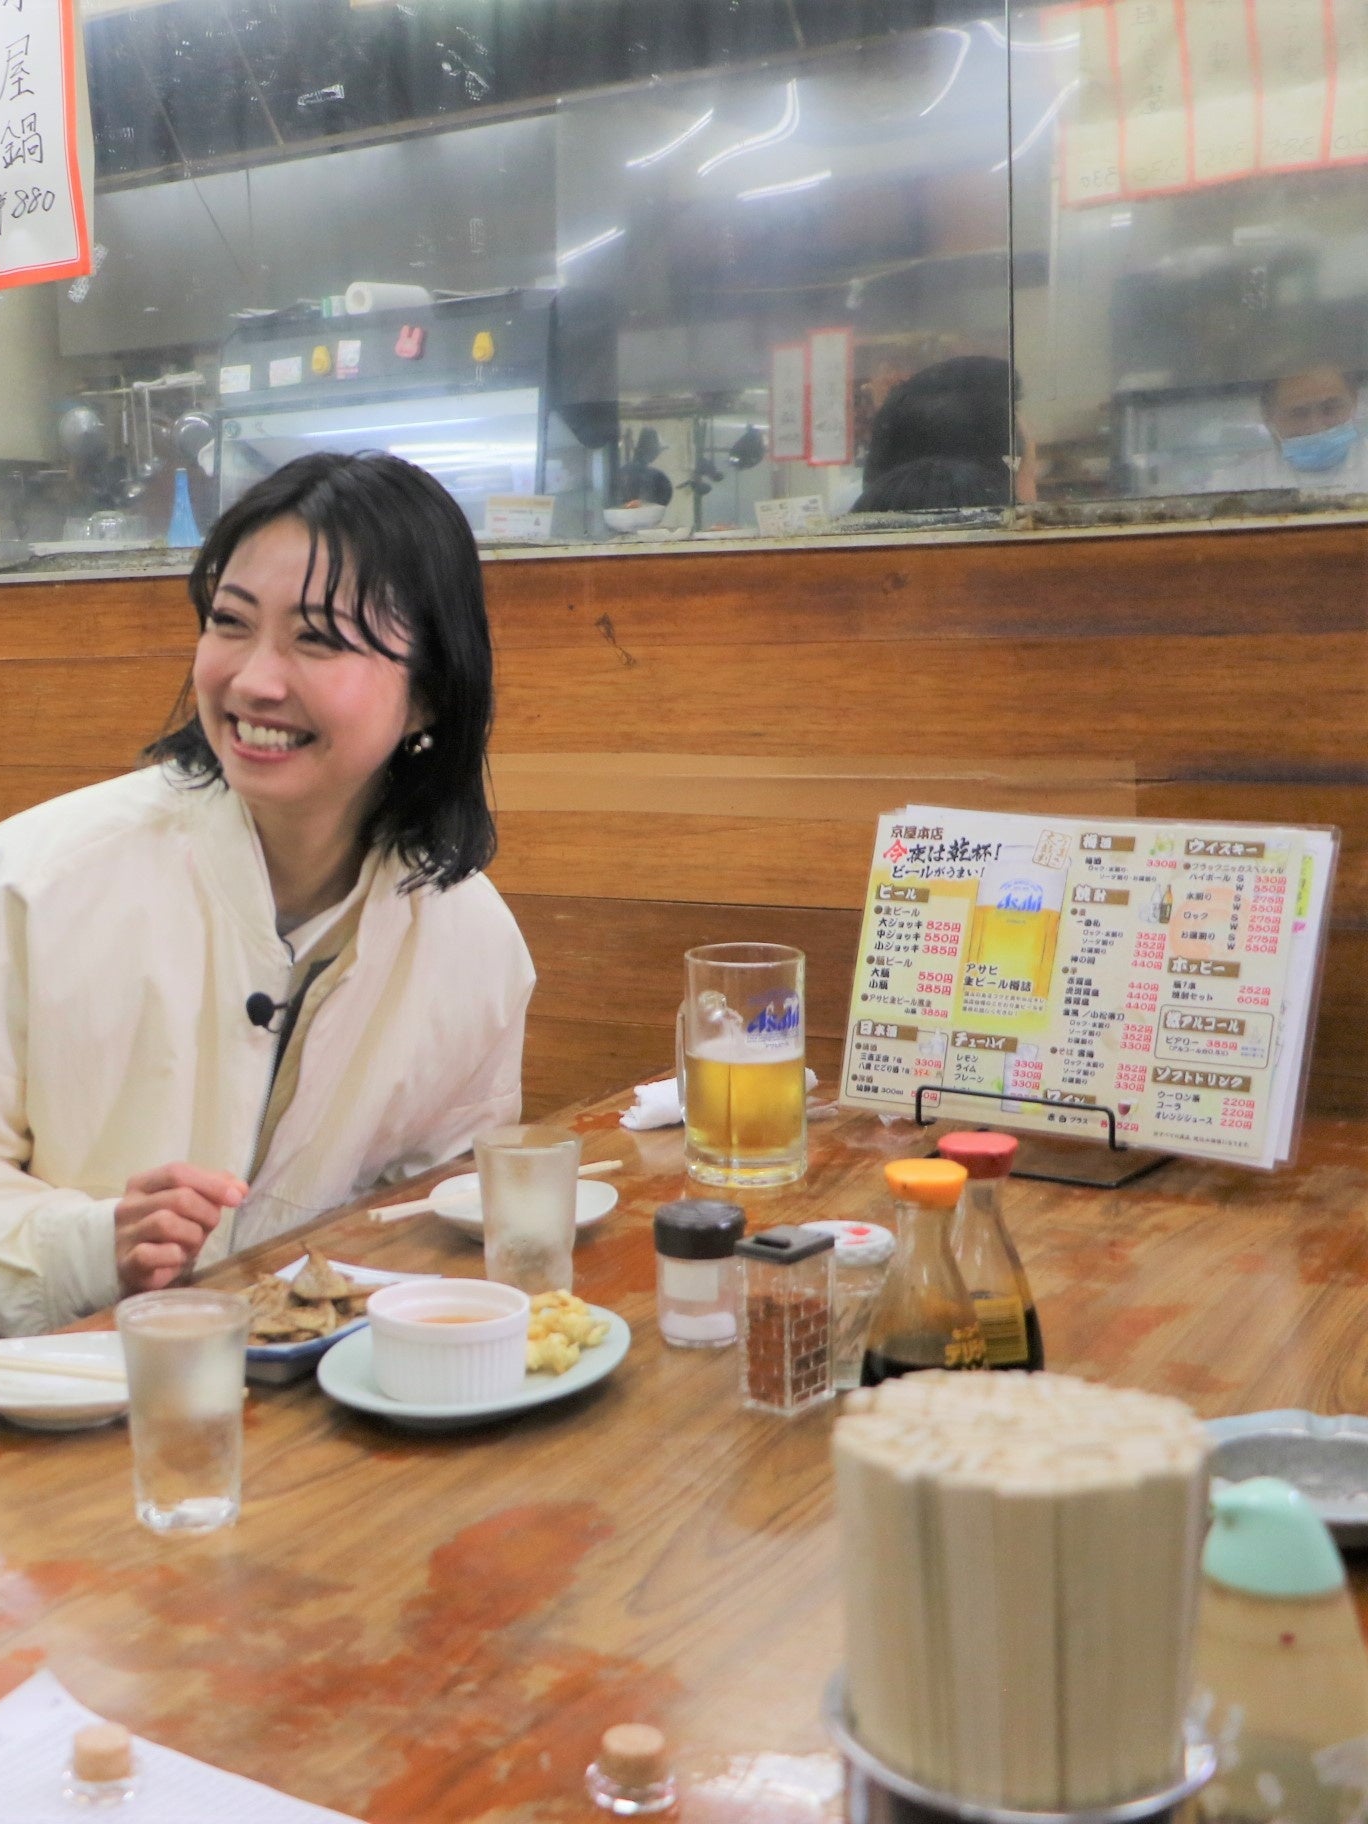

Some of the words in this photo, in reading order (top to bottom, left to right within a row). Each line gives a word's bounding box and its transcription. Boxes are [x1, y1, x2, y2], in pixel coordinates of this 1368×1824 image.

[890, 824, 944, 841] 京屋本店
[883, 837, 1003, 864] 今夜は乾杯!
[1187, 838, 1258, 856] ウイスキー
[1146, 858, 1178, 869] 330円
[891, 866, 986, 880] ビールがうまい!
[1255, 874, 1288, 885] 330円
[878, 883, 917, 900] ビール
[1253, 885, 1286, 895] 550円
[995, 891, 1044, 914] Asahi
[1249, 904, 1283, 915] 550円
[878, 918, 923, 930] 大ジョッキ
[926, 920, 961, 933] 825円
[1247, 924, 1280, 935] 550円
[876, 930, 921, 942] 中ジョッキ
[924, 933, 960, 945] 550円
[1136, 931, 1167, 942] 352円
[874, 941, 919, 954] 小ジョッキ
[922, 944, 958, 957] 385円
[1134, 940, 1165, 951] 352円
[1244, 944, 1278, 954] 550円
[1133, 950, 1164, 960] 330円
[966, 963, 999, 977] アサヒ
[1131, 960, 1163, 971] 440円
[918, 971, 954, 983] 550円
[916, 983, 952, 996] 385円
[1128, 981, 1159, 992] 440円
[1126, 991, 1158, 1002] 440円
[921, 1008, 948, 1019] 385円
[1125, 1002, 1157, 1013] 440円
[1123, 1023, 1153, 1035] 352円
[953, 1031, 1008, 1050] チューハイ
[1121, 1032, 1152, 1043] 352円
[1120, 1041, 1151, 1052] 330円
[914, 1058, 943, 1069] 330円
[1014, 1059, 1044, 1070] 330円
[1117, 1062, 1148, 1074] 352円
[1012, 1069, 1042, 1081] 330円
[1115, 1071, 1147, 1083] 352円
[1156, 1065, 1244, 1089] ソフトドリンク
[1011, 1079, 1041, 1091] 330円
[1114, 1081, 1145, 1093] 330円
[909, 1090, 939, 1102] 50円
[1222, 1098, 1255, 1109] 220円
[1156, 1101, 1182, 1110] コーラ
[1221, 1108, 1254, 1119] 220円
[1100, 1120, 1140, 1132] 各52円
[1219, 1118, 1253, 1130] 220円
